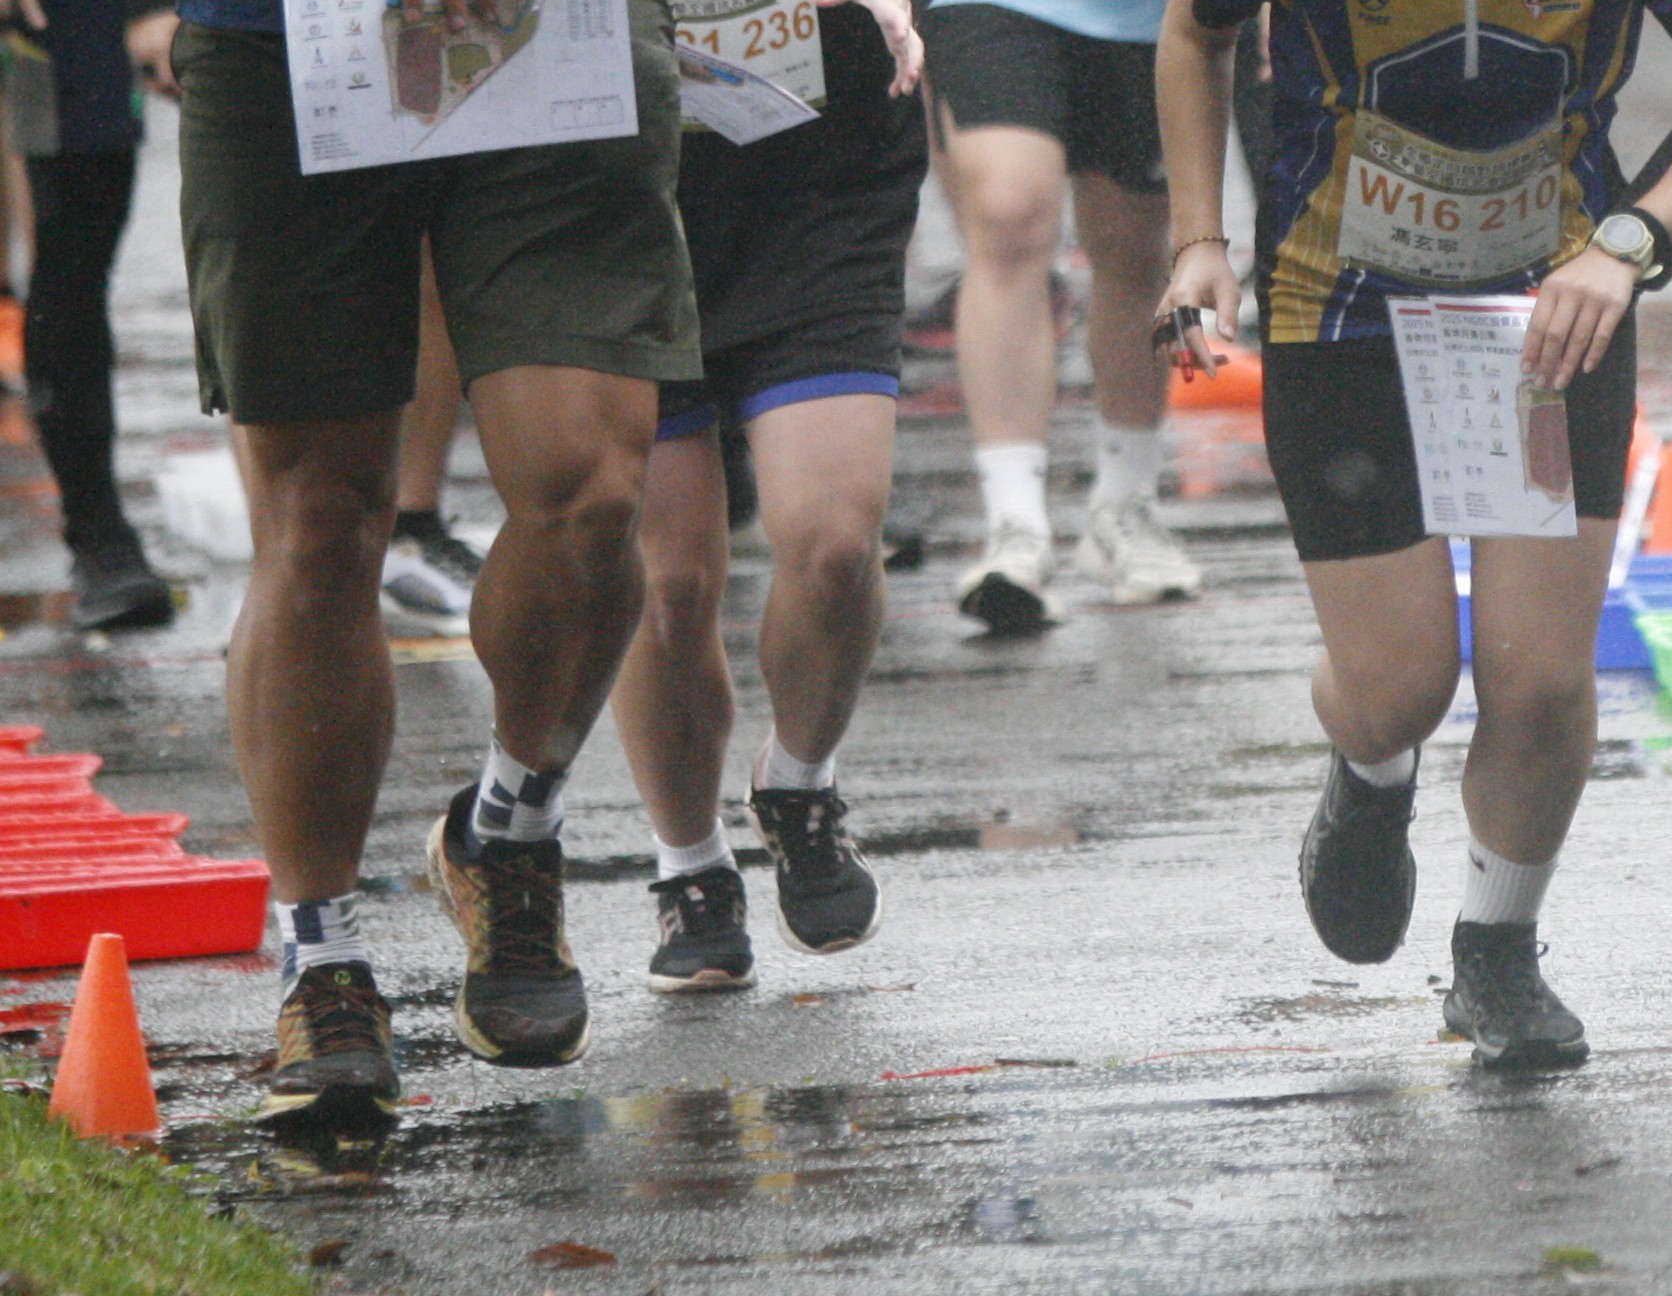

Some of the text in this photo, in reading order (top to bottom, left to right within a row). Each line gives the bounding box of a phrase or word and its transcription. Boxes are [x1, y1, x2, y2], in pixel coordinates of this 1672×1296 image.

[743, 1, 814, 59] 236
[1359, 165, 1461, 232] W16
[1479, 175, 1557, 233] 210
